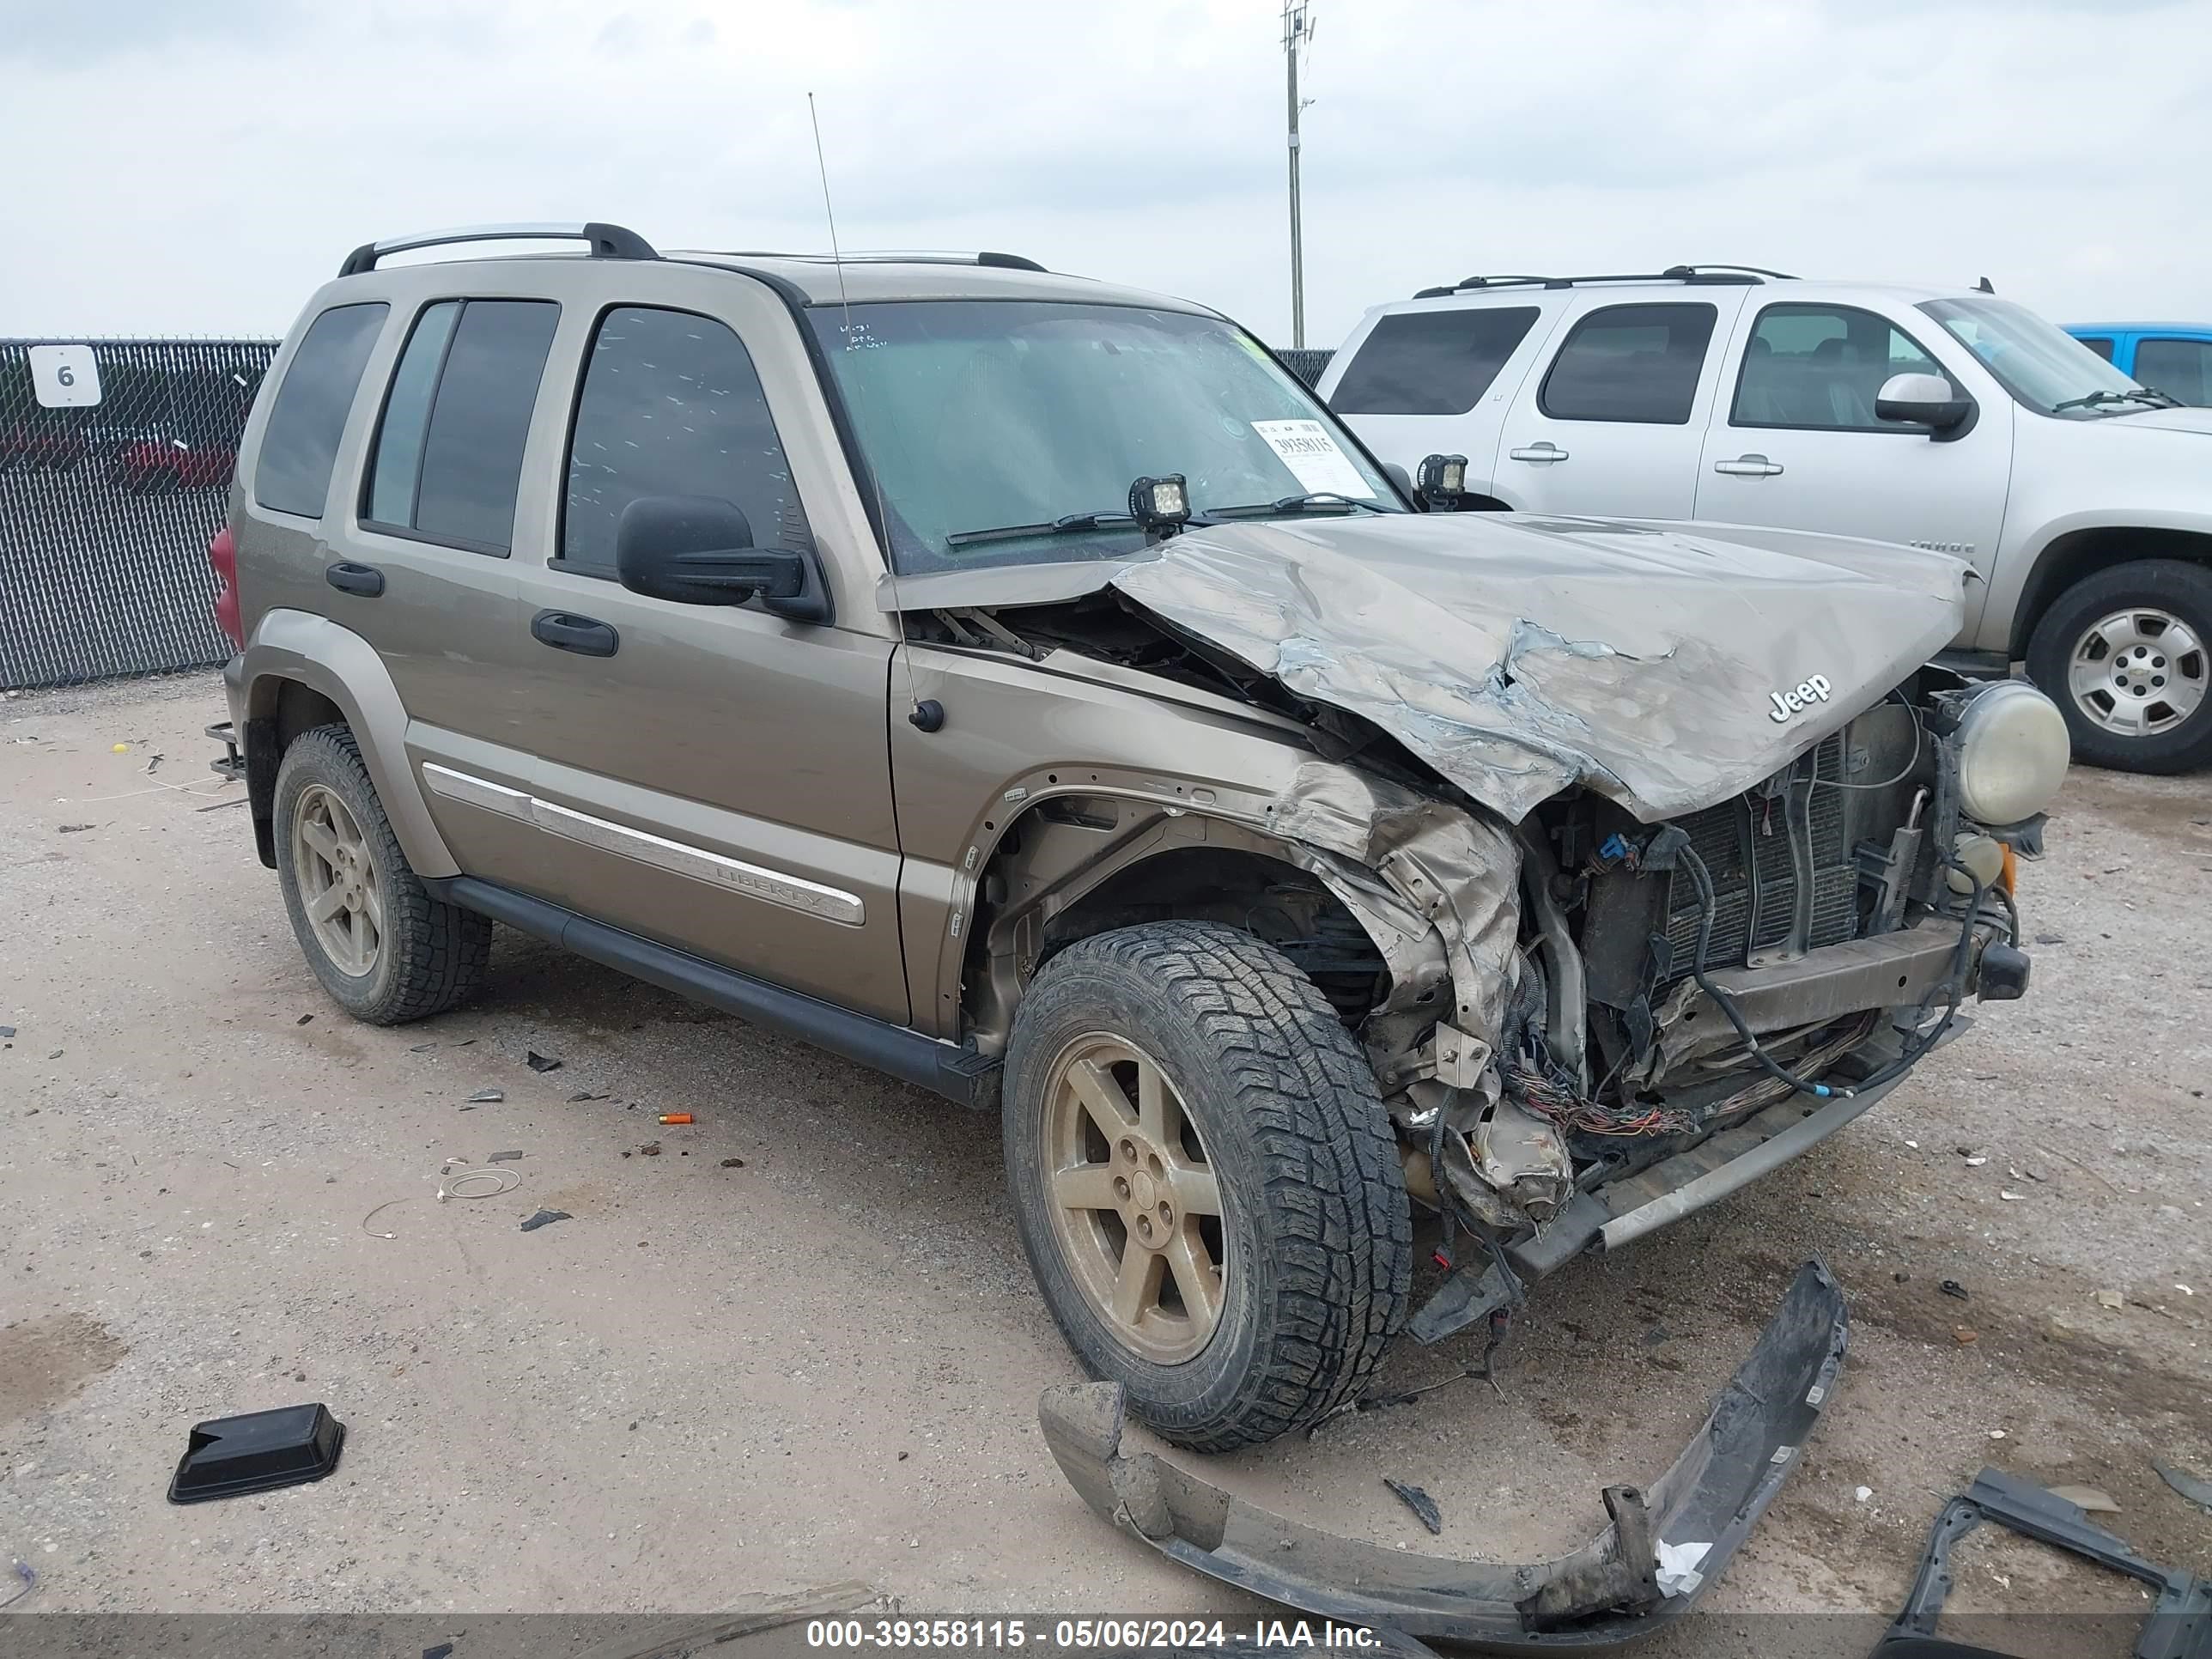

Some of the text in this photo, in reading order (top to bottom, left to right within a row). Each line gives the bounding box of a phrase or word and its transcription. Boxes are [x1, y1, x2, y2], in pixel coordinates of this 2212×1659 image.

[58, 366, 75, 386] 6
[1274, 437, 1333, 454] 39358115
[1769, 674, 1831, 722] Jeep
[717, 867, 822, 908] LIBERTY
